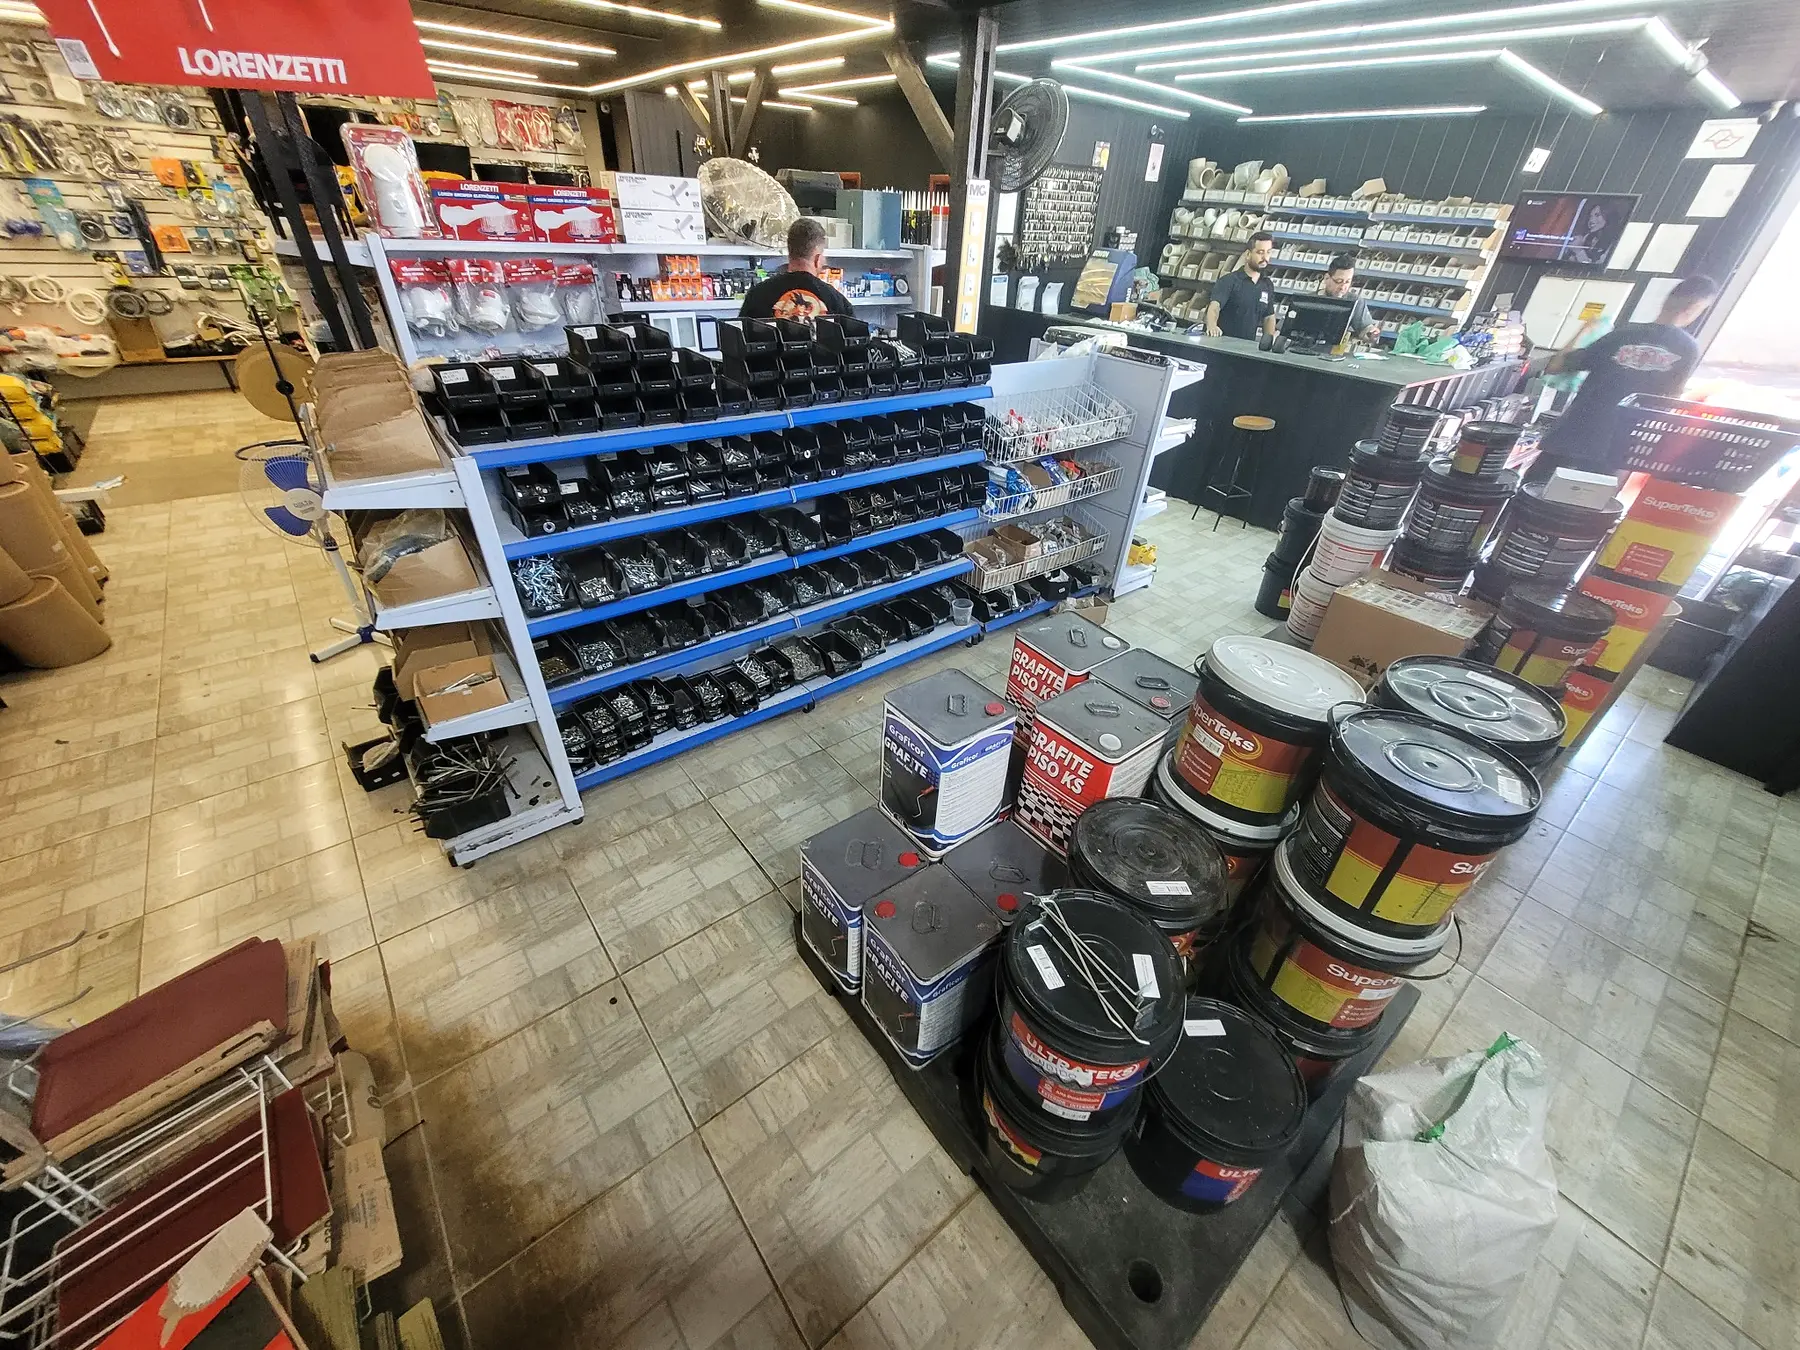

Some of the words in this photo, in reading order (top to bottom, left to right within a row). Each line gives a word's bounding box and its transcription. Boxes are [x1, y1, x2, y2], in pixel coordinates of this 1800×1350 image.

[178, 47, 347, 84] LORENZETTI
[460, 183, 499, 193] LORENZETTI
[1642, 496, 1716, 519] SuperTeks
[1011, 666, 1038, 692] PISO
[1012, 647, 1064, 690] GRAFITE
[884, 736, 929, 779] GRAFITE
[889, 724, 926, 758] Graficor
[951, 752, 979, 769] Graficor
[1030, 726, 1094, 779] GRAFITE
[1028, 744, 1059, 778] PISO
[1060, 773, 1085, 795] KS
[802, 879, 840, 928] GRAFITE
[805, 870, 835, 909] Graficor
[866, 946, 910, 1004] GRAFITE
[870, 938, 906, 984] Graficor
